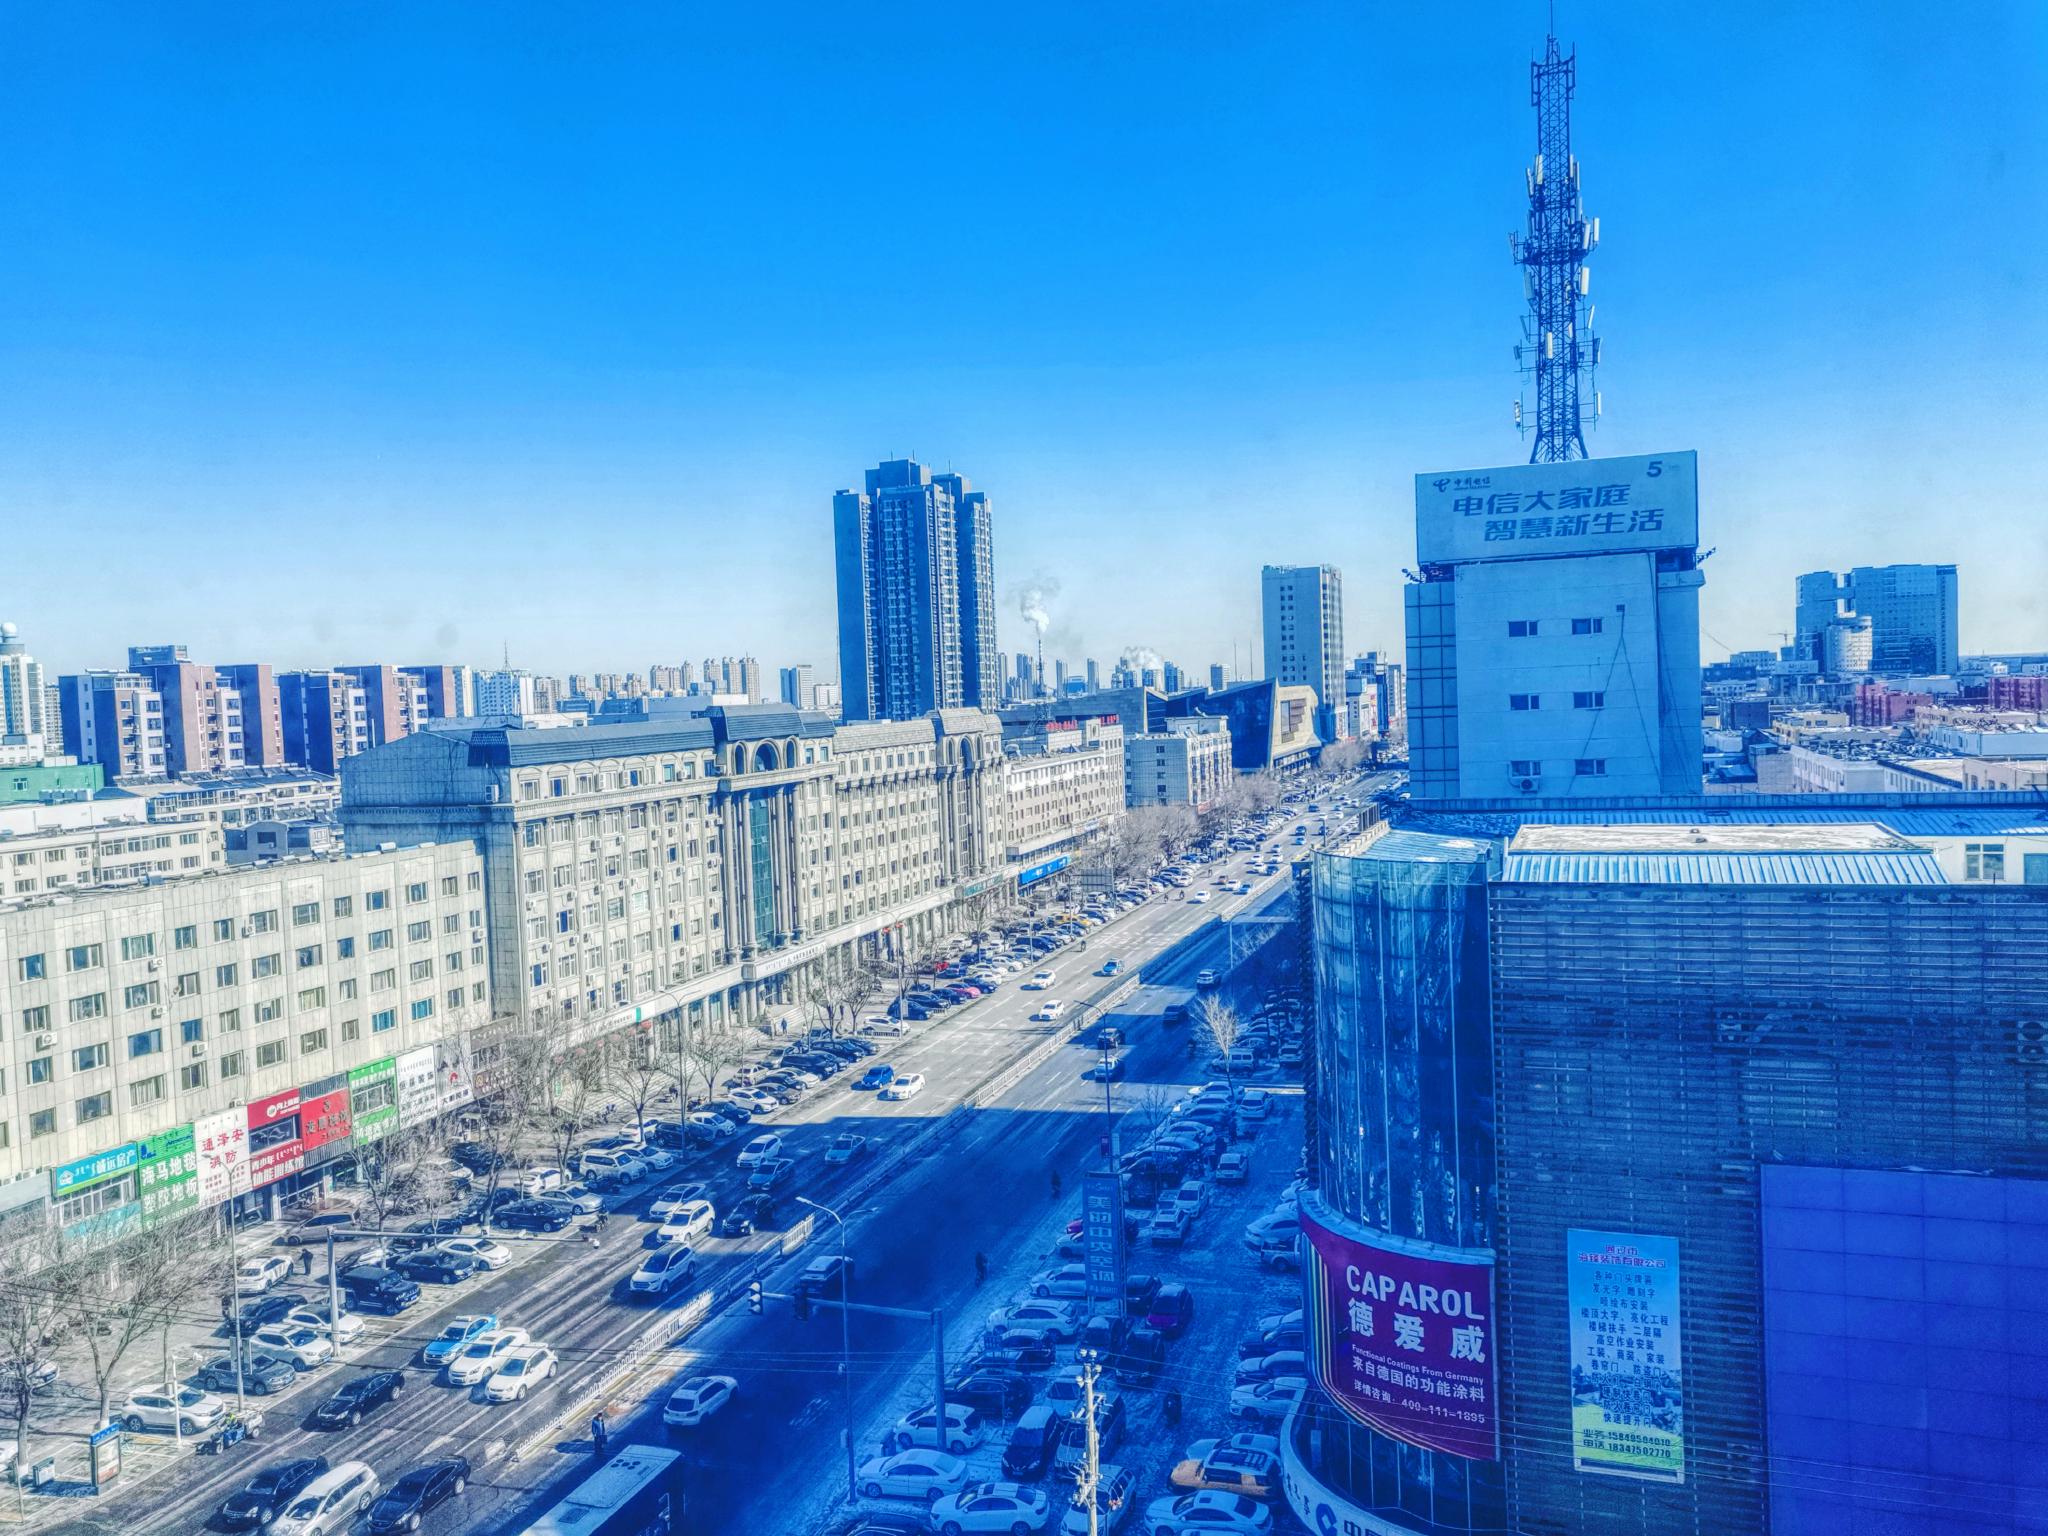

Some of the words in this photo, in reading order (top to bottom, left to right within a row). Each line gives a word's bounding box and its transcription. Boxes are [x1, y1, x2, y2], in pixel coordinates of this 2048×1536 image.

[1453, 484, 1631, 517] 电信大家庭
[1484, 508, 1665, 542] 智慧新生活
[142, 1152, 197, 1186] 海马地毯
[143, 1177, 198, 1214] 塑胶地板
[1087, 1195, 1115, 1282] 美的中央空调
[1346, 1264, 1485, 1320] CAPAROL
[1348, 1297, 1486, 1363] 德爱威
[1596, 1335, 1655, 1351] 高空作业安装
[1352, 1344, 1386, 1363] Functional
[1386, 1356, 1420, 1373] Coatings
[1421, 1366, 1443, 1378] From
[1445, 1370, 1484, 1385] Germany
[1352, 1356, 1486, 1403] 来自德国的功能涂料
[1583, 1439, 1605, 1449] 电话
